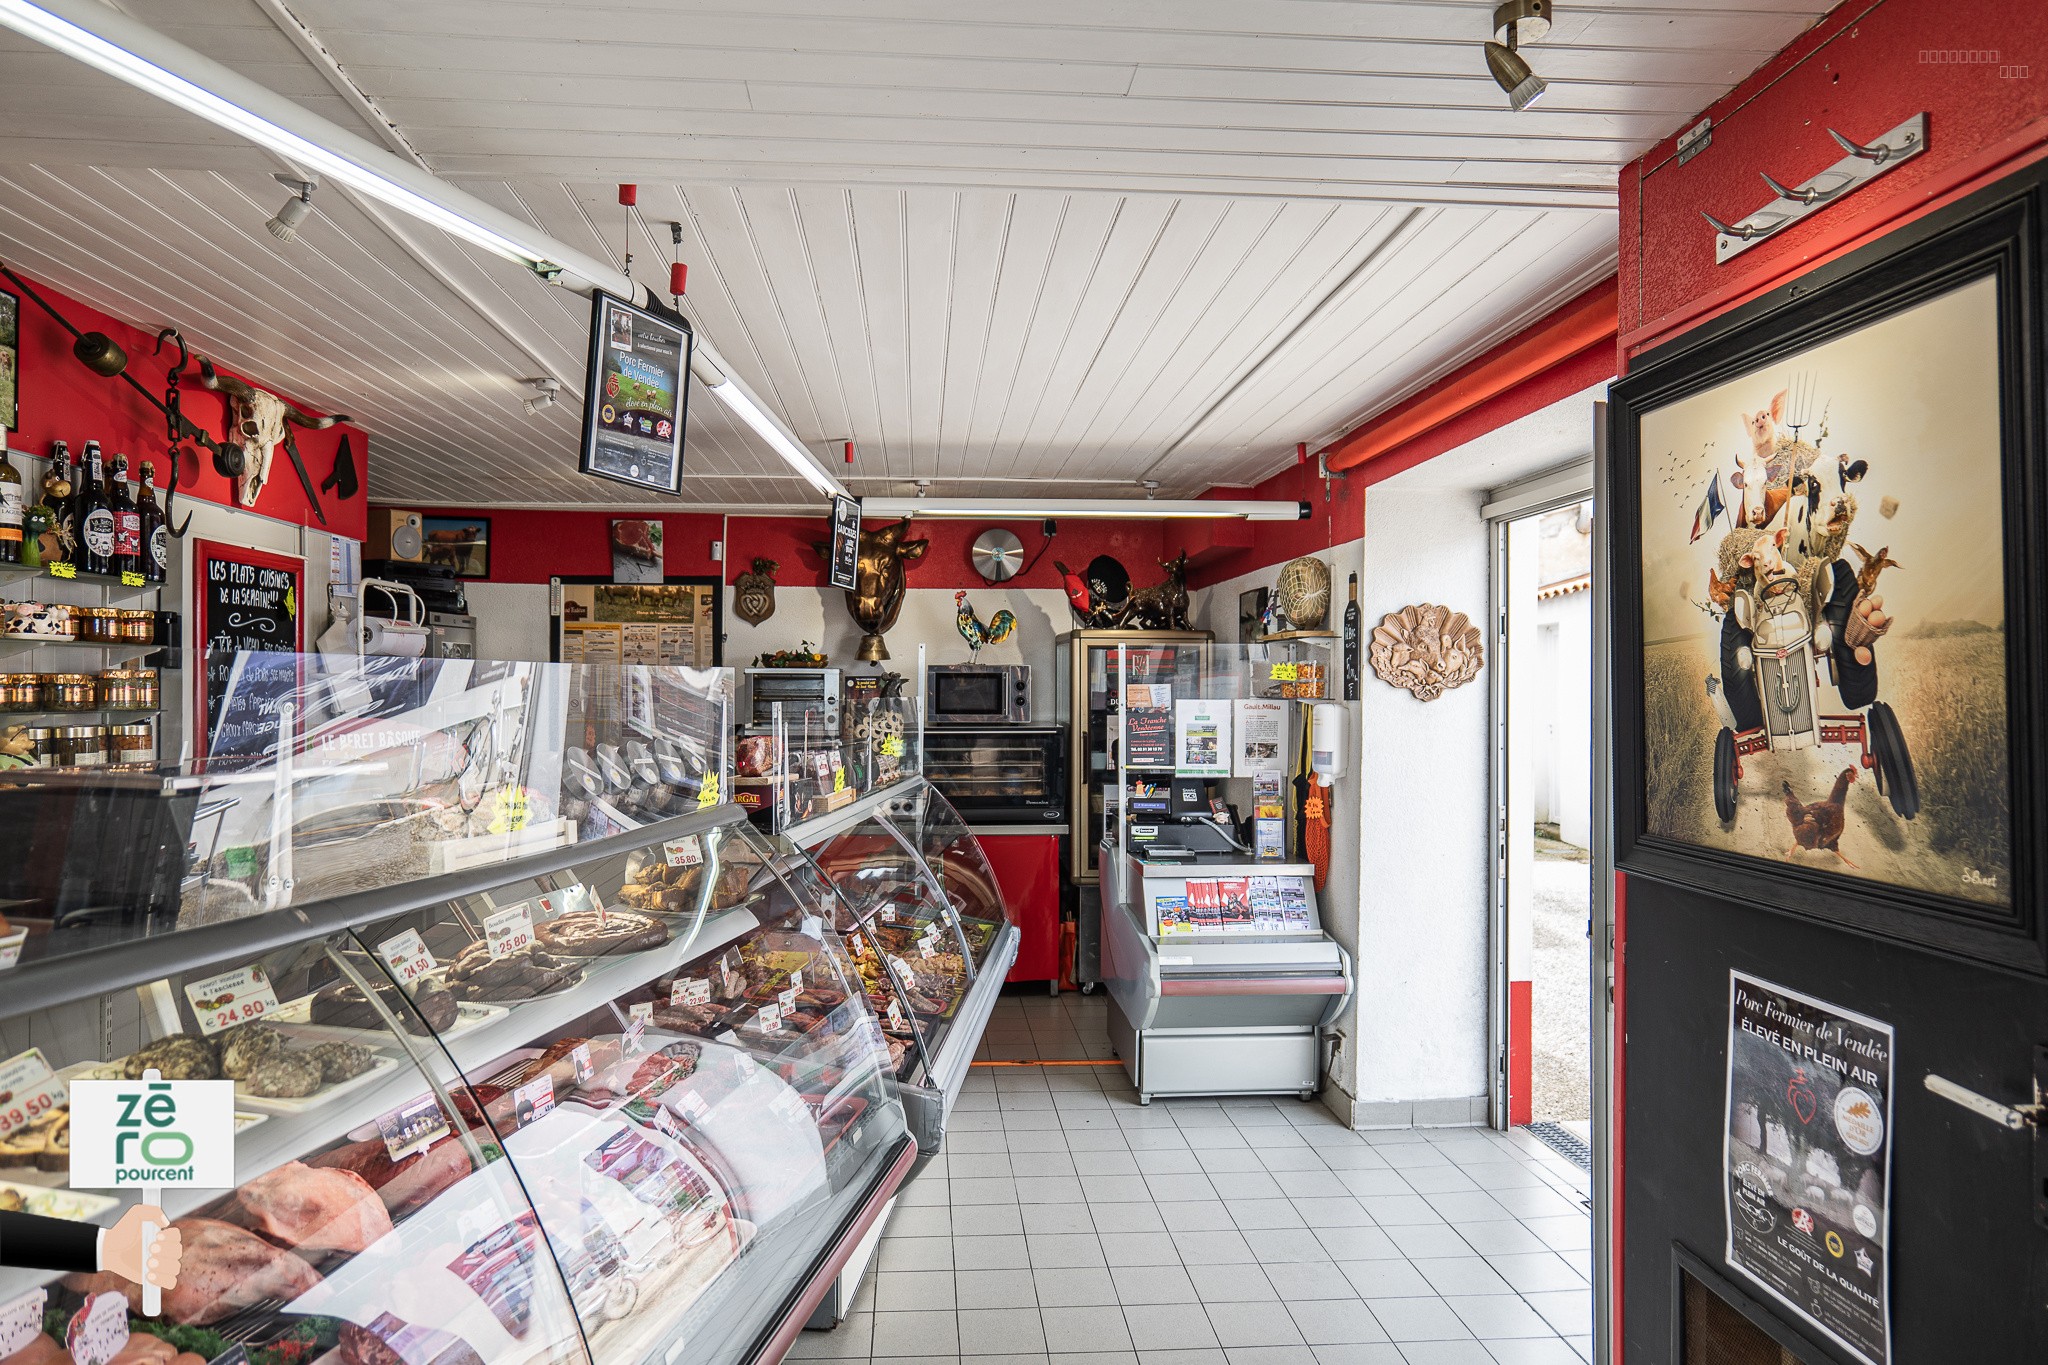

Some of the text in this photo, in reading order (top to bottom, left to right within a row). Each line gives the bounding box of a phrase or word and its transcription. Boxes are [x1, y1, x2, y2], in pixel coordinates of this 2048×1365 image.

[620, 351, 664, 378] Porc Fermier
[624, 366, 659, 388] de Vendée
[230, 563, 255, 584] PLATS
[220, 587, 229, 604] DE
[232, 588, 240, 605] LA
[321, 734, 336, 751] LE
[733, 794, 759, 803] ARGAL
[674, 855, 697, 865] 35.80
[493, 946, 499, 954] €
[499, 933, 527, 954] 25.80
[403, 957, 429, 979] 24.50
[689, 995, 706, 1005] 22.90
[206, 999, 276, 1027] € 24.80 kg
[1736, 989, 1888, 1063] Porc Fermier de Vendée
[1741, 1017, 1878, 1088] ÉLEVÉ EN PLEIN AIR
[1735, 1162, 1751, 1179] PORC
[1777, 1235, 1788, 1248] LE
[1788, 1243, 1812, 1264] GOÛT
[1813, 1258, 1825, 1274] DE
[1826, 1267, 1838, 1282] LA
[1839, 1275, 1880, 1310] QUALITÉ
